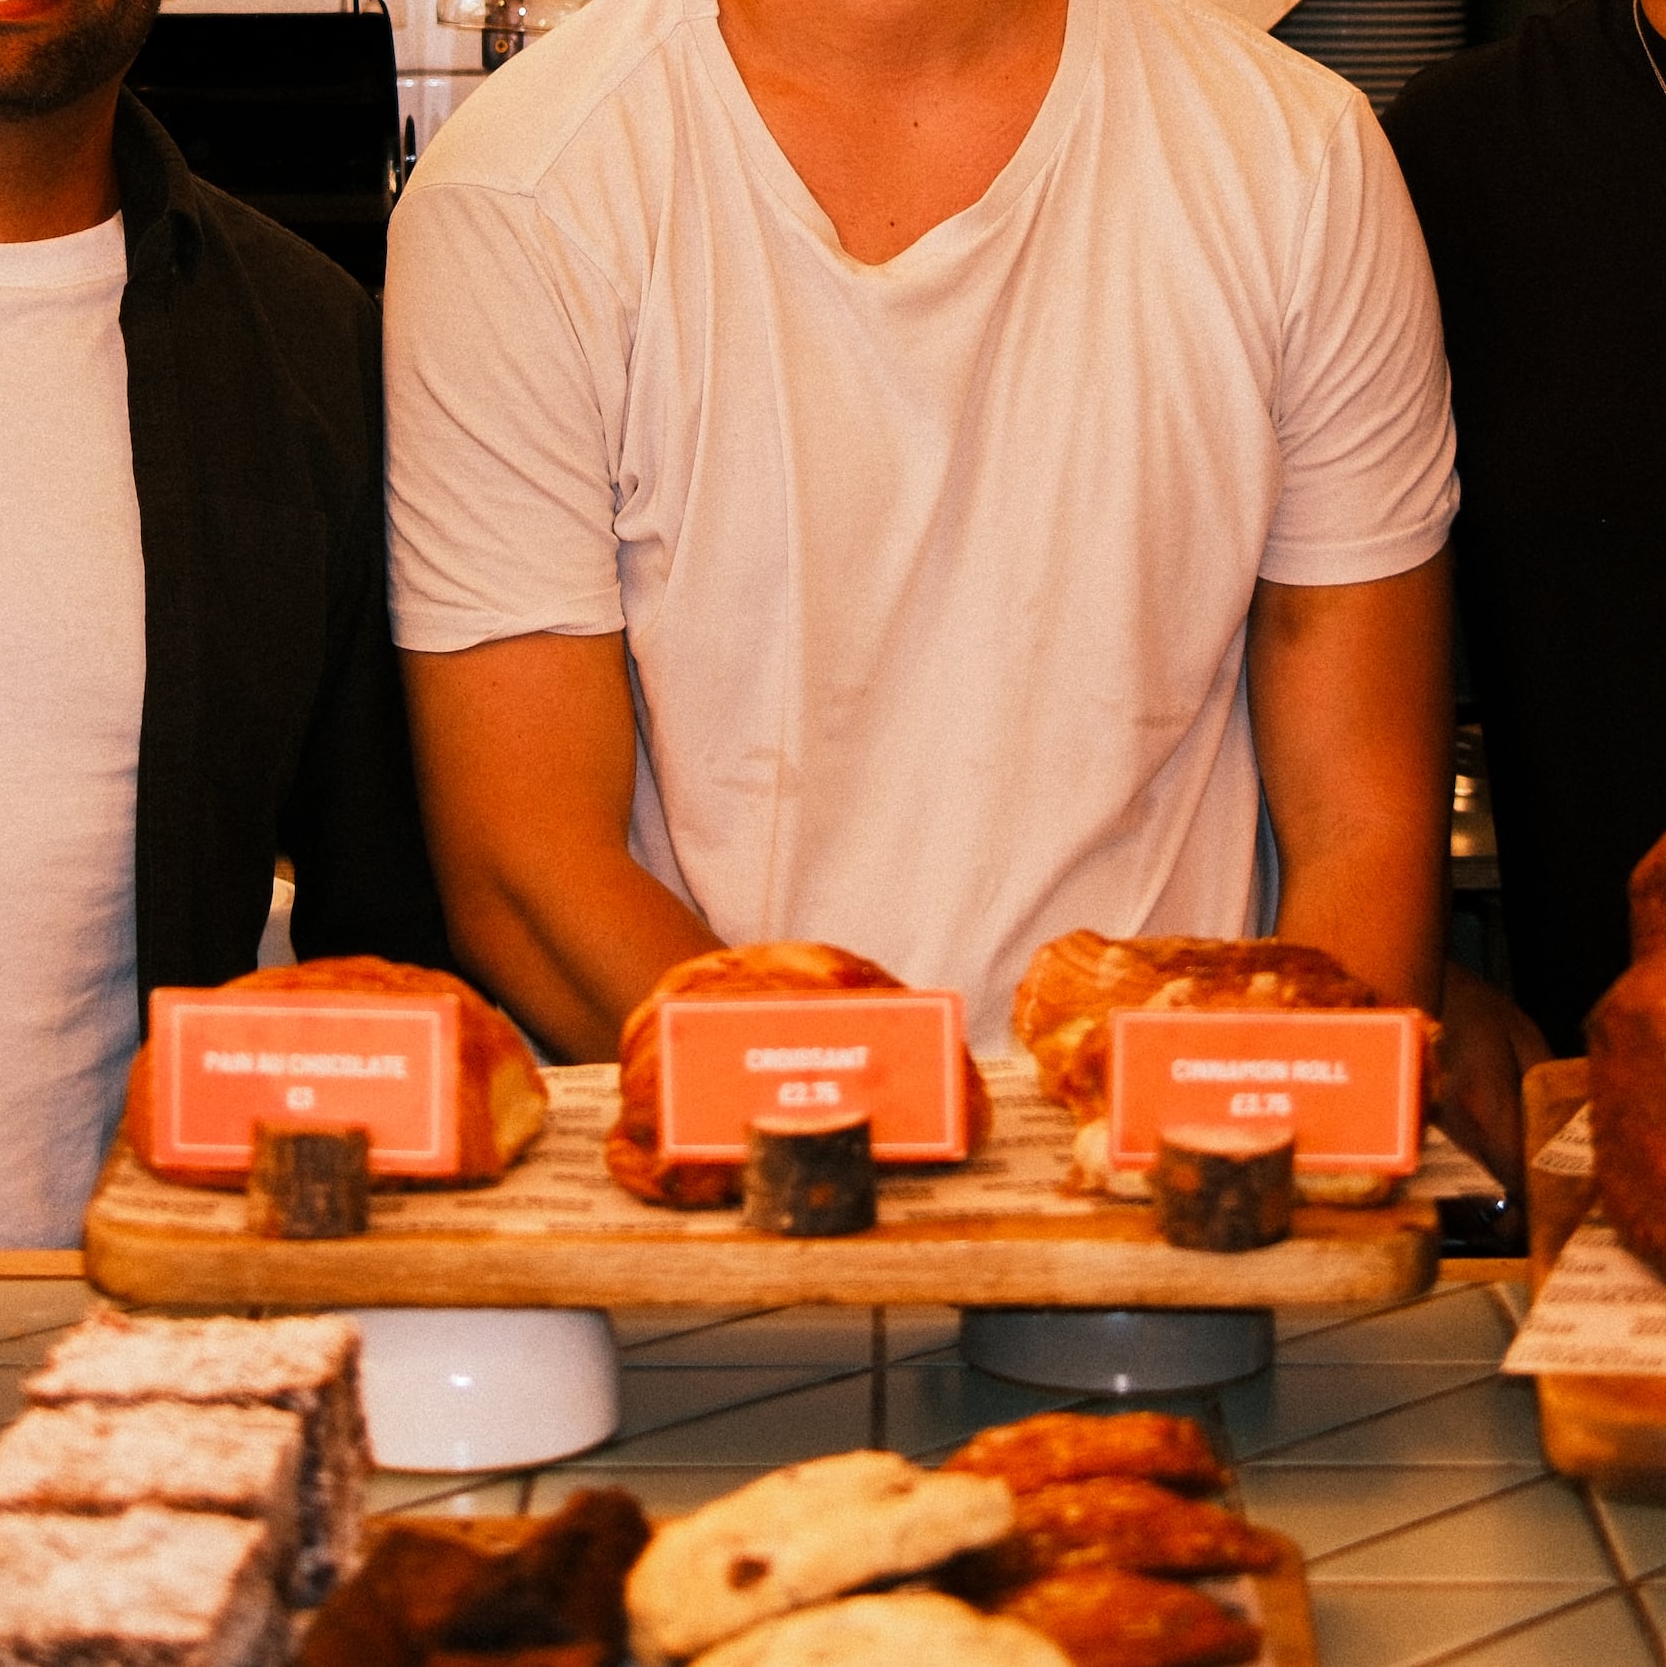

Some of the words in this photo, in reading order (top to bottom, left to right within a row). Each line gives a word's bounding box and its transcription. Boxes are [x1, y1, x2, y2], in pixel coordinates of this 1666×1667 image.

[745, 1046, 869, 1072] CROISSANT
[1171, 1059, 1289, 1082] CINNAMON
[1292, 1059, 1350, 1084] ROLL
